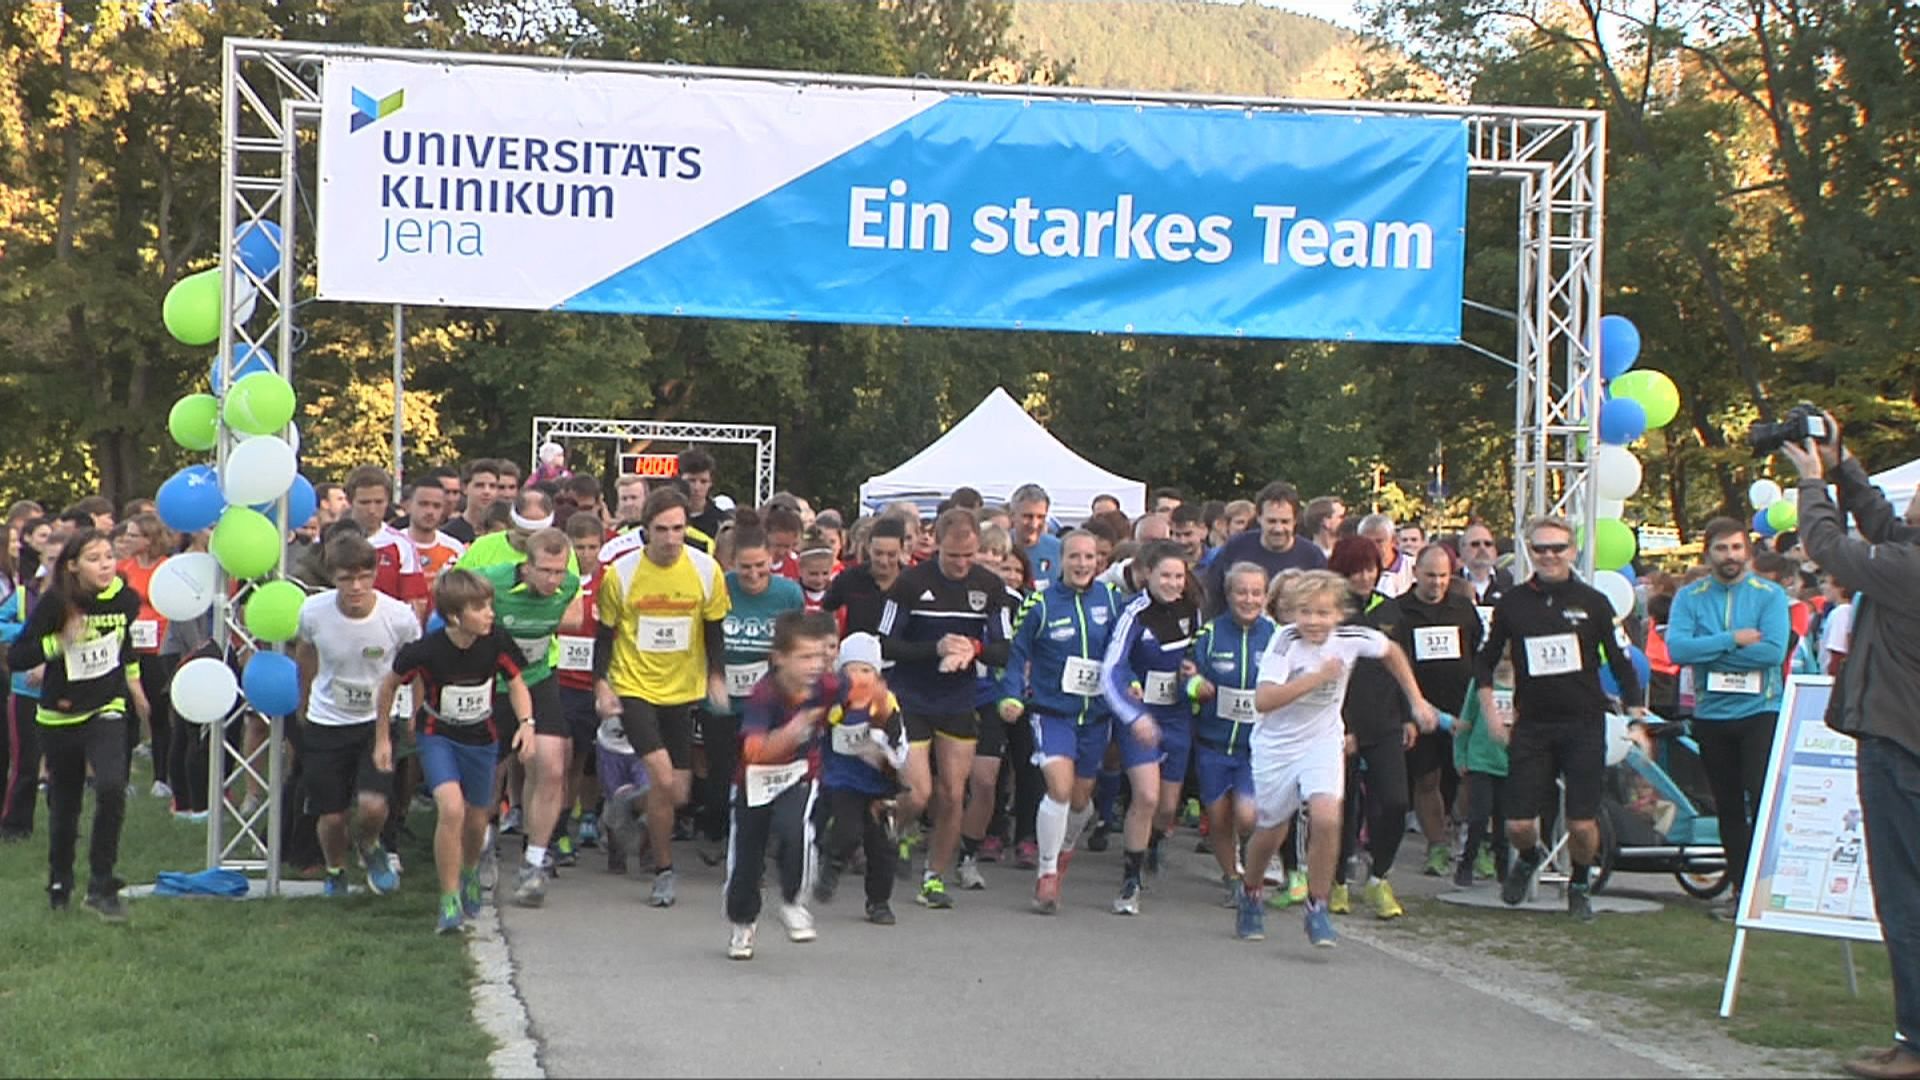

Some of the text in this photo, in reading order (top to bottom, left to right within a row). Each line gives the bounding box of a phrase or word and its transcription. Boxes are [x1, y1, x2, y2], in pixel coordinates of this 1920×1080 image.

[847, 179, 1433, 270] Ein starkes Team
[80, 648, 109, 665] 116
[734, 672, 758, 684] 197
